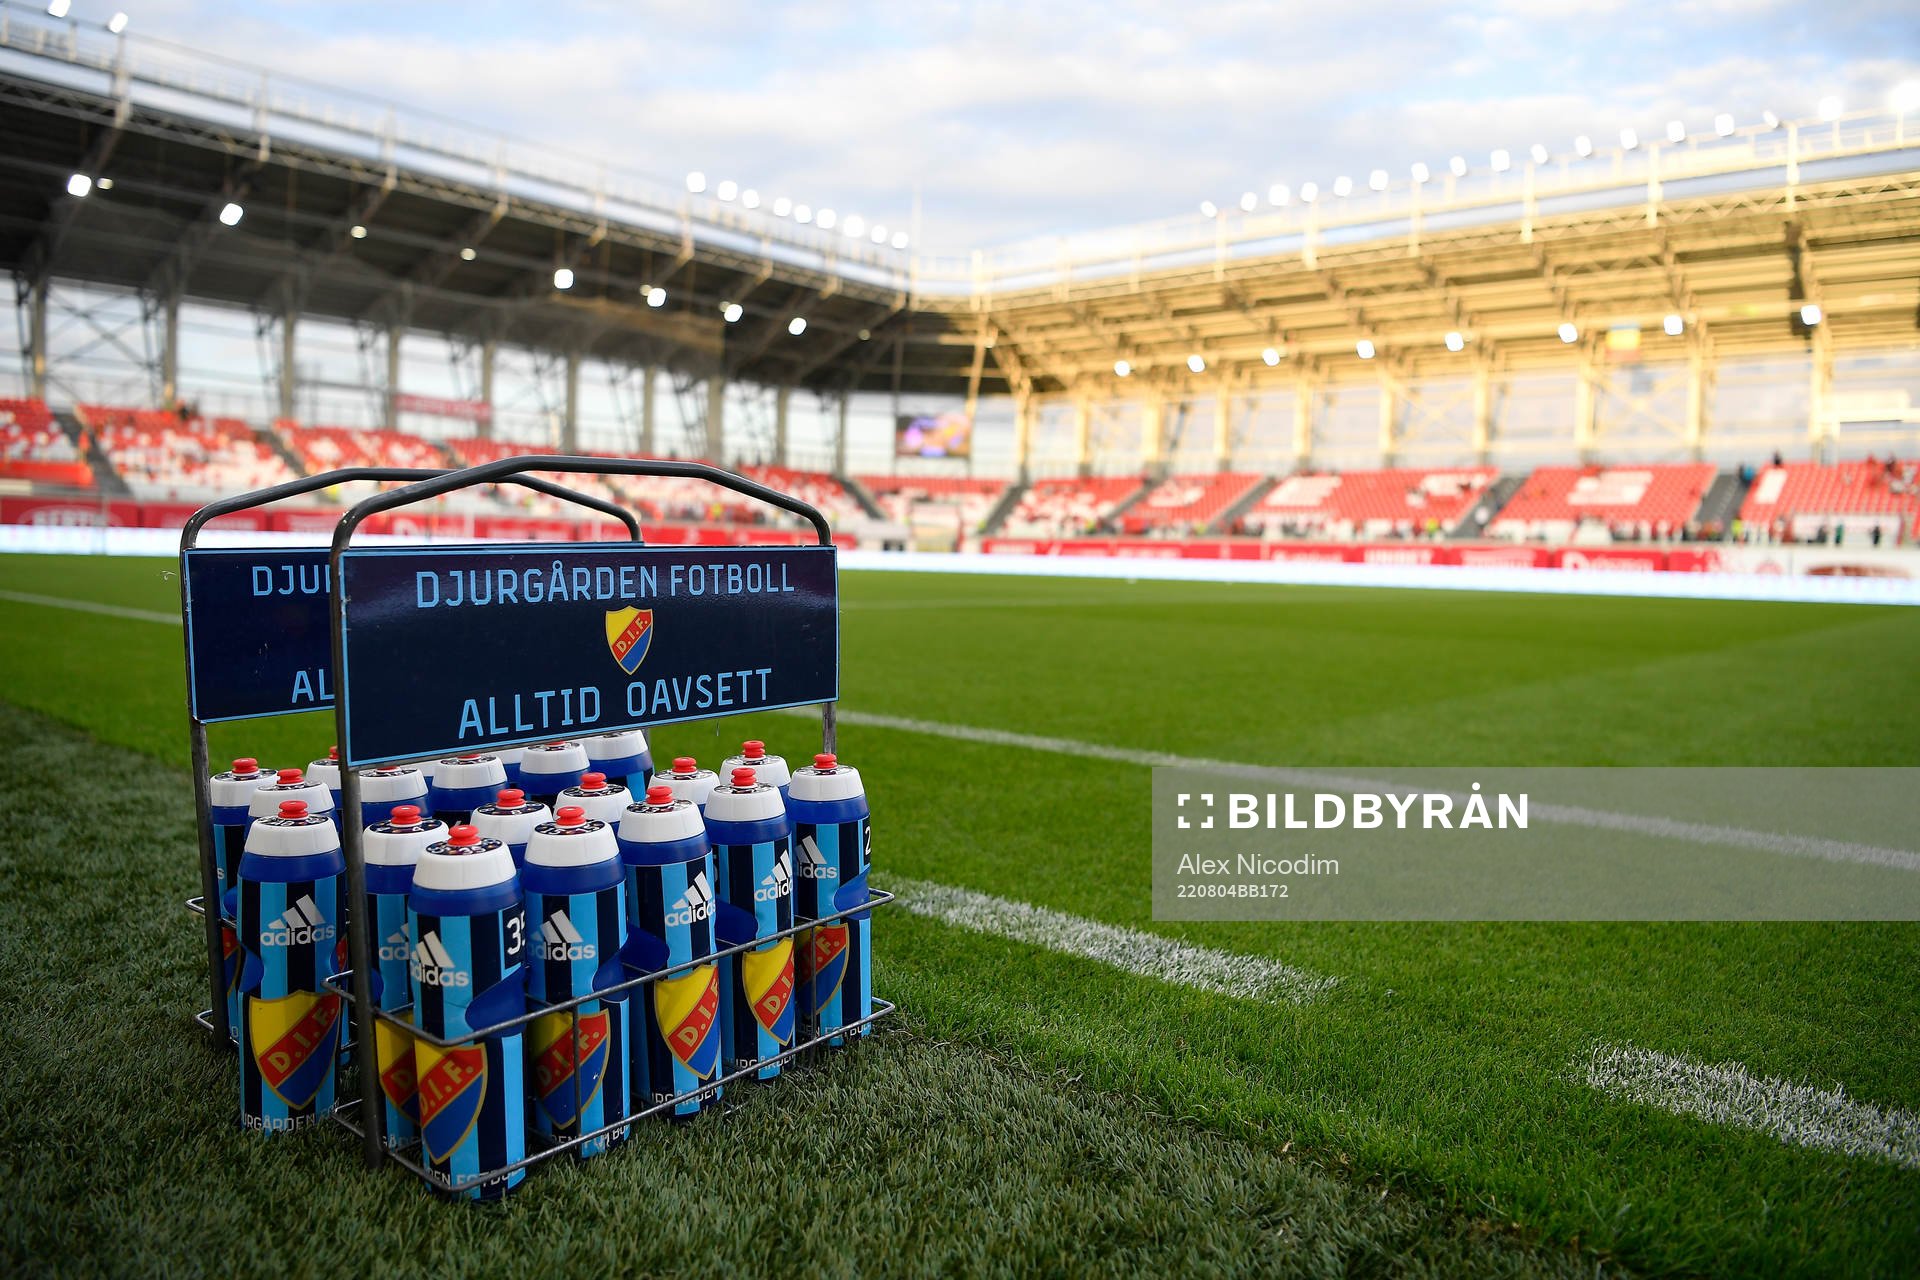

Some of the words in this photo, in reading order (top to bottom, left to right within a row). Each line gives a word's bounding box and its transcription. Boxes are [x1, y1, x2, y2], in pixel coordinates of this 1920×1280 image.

[416, 559, 657, 608] DJURGÅRDEN
[670, 562, 795, 597] FOTBOLL
[615, 617, 648, 653] D.I.F.
[458, 685, 600, 739] ALLTID
[626, 667, 773, 718] OAVSETT
[260, 924, 336, 947] adidas
[267, 1007, 336, 1074] D.I.F.
